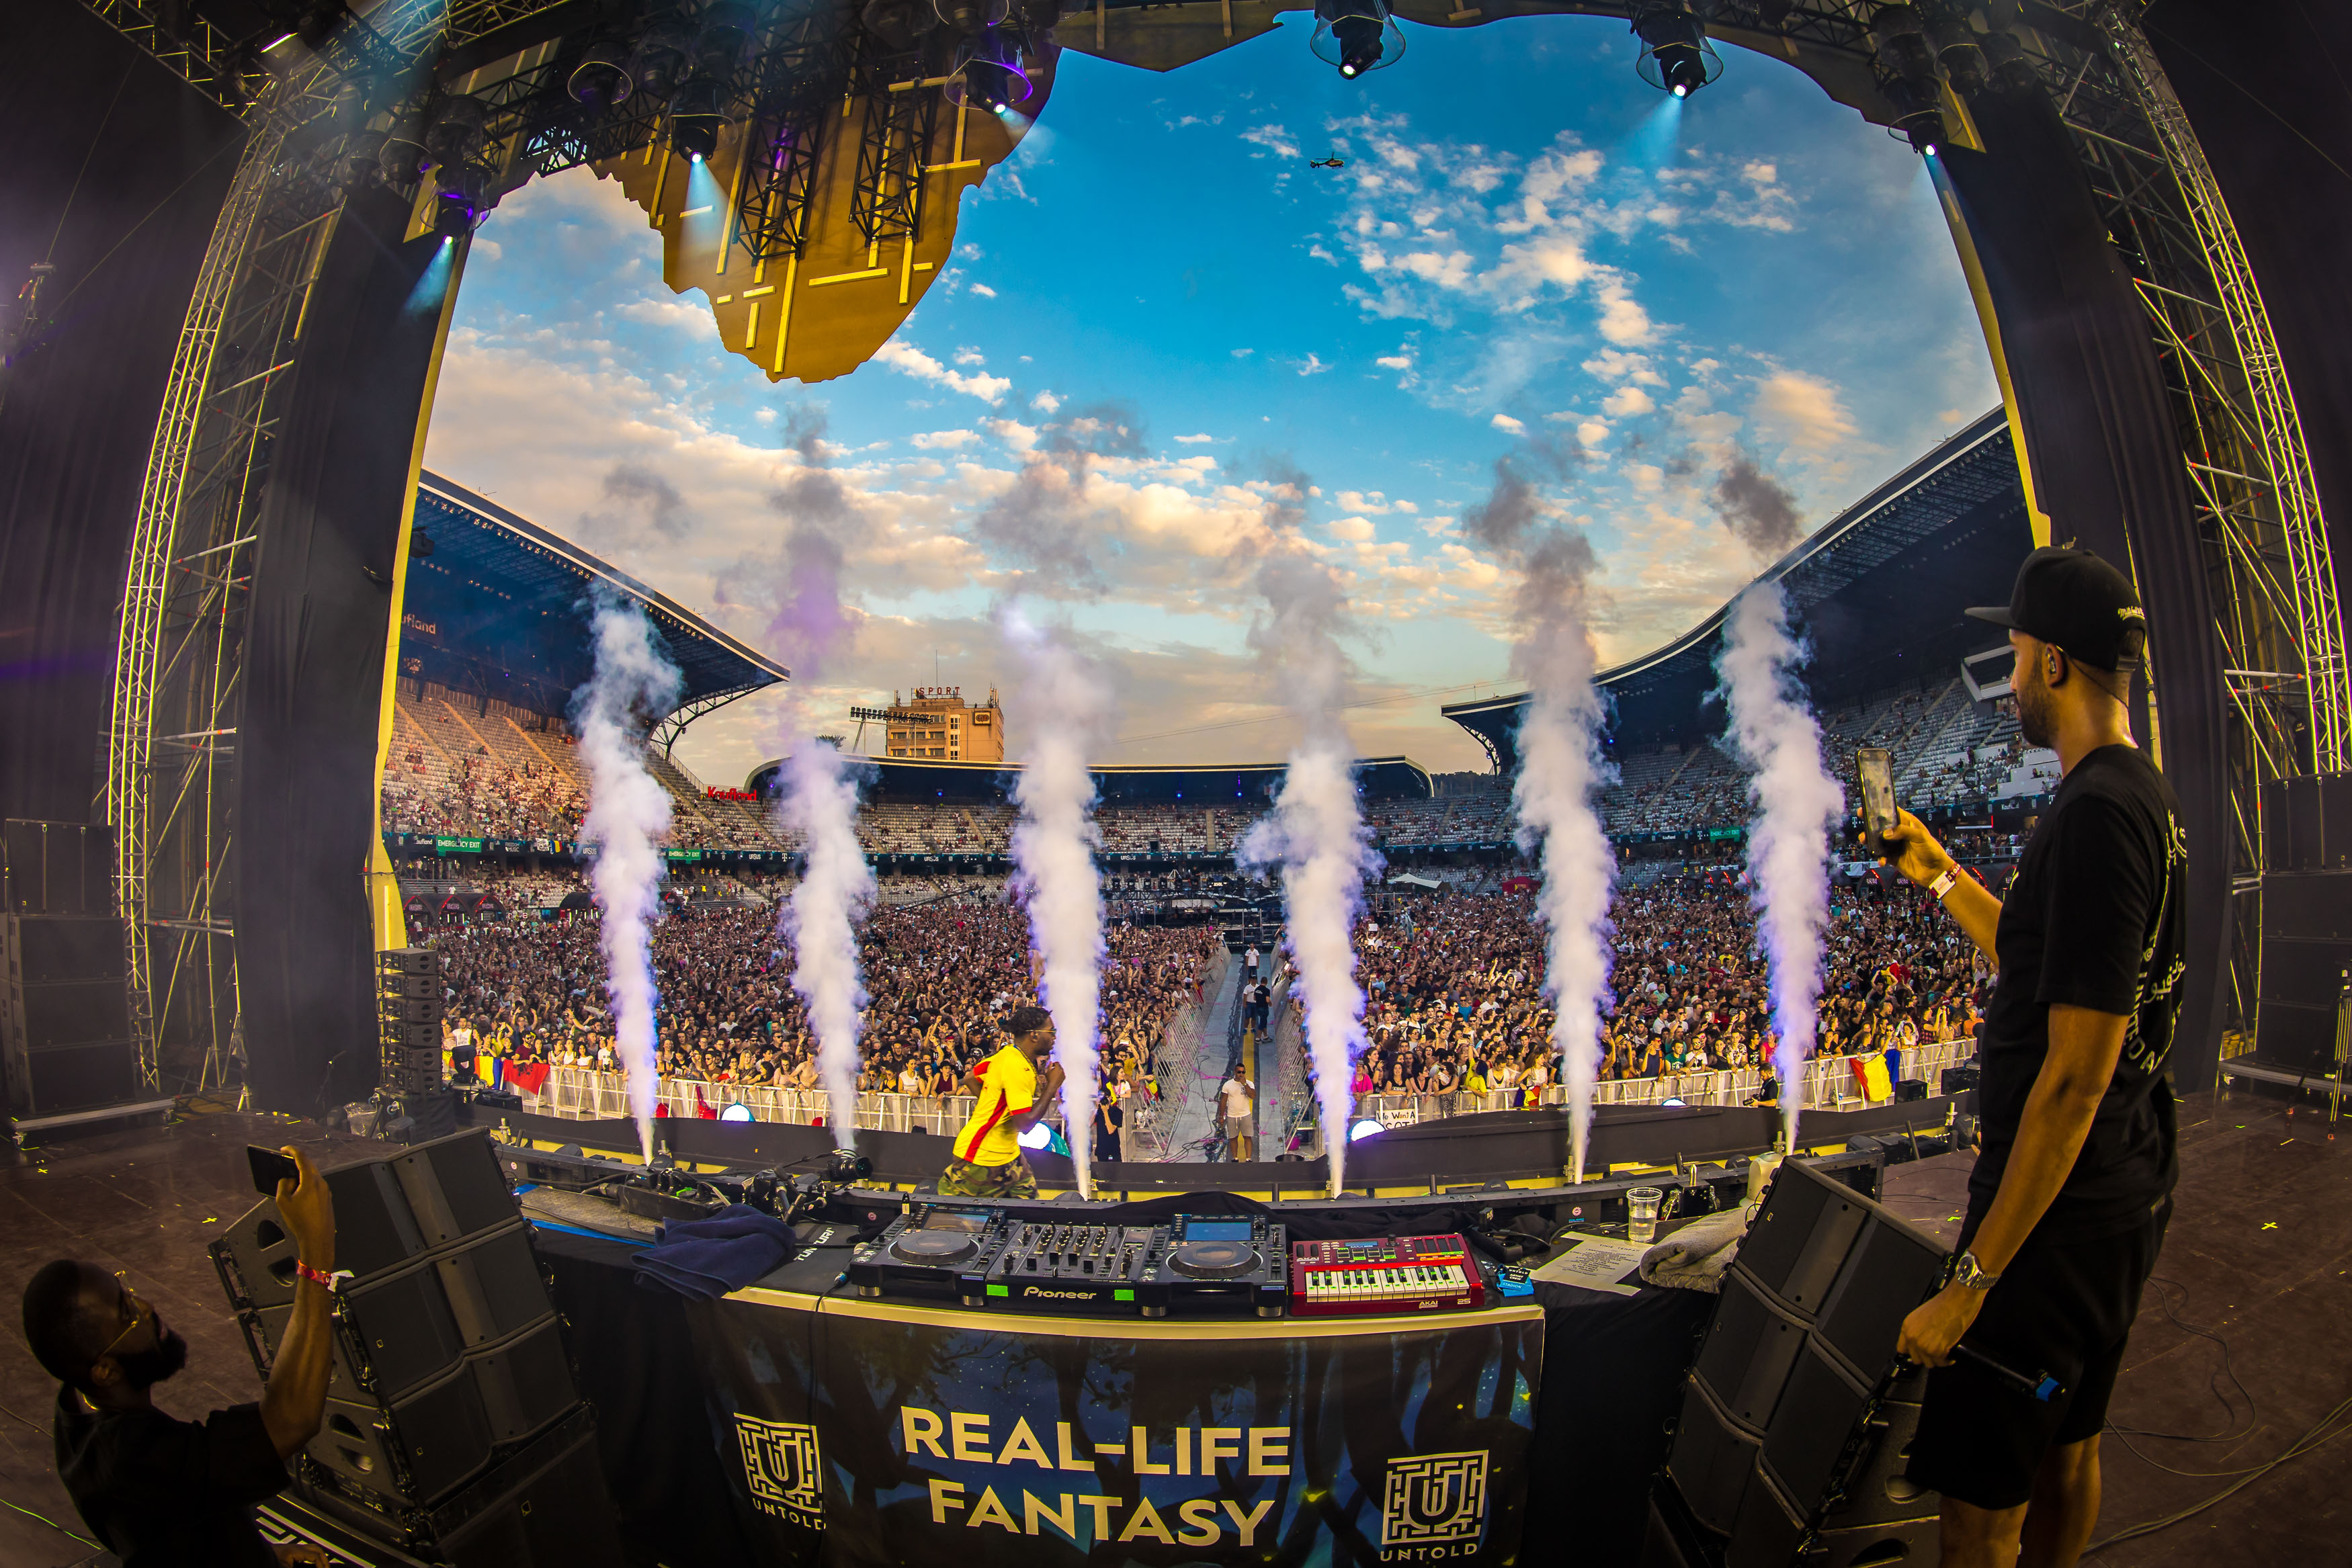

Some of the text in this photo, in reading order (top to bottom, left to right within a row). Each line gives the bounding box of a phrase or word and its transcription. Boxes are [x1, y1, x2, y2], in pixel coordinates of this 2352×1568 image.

[402, 613, 436, 635] ufland
[919, 687, 960, 695] SPORT
[708, 786, 757, 801] Kaufland
[437, 840, 468, 848] EMERGCY
[583, 847, 597, 855] URSUS
[1023, 1286, 1097, 1300] Pioneer
[900, 1405, 1291, 1476] REAL-LIFE
[753, 1497, 827, 1530] UNTOLD
[928, 1479, 1275, 1547] FANTASY
[1380, 1542, 1478, 1562] UNTOLD
